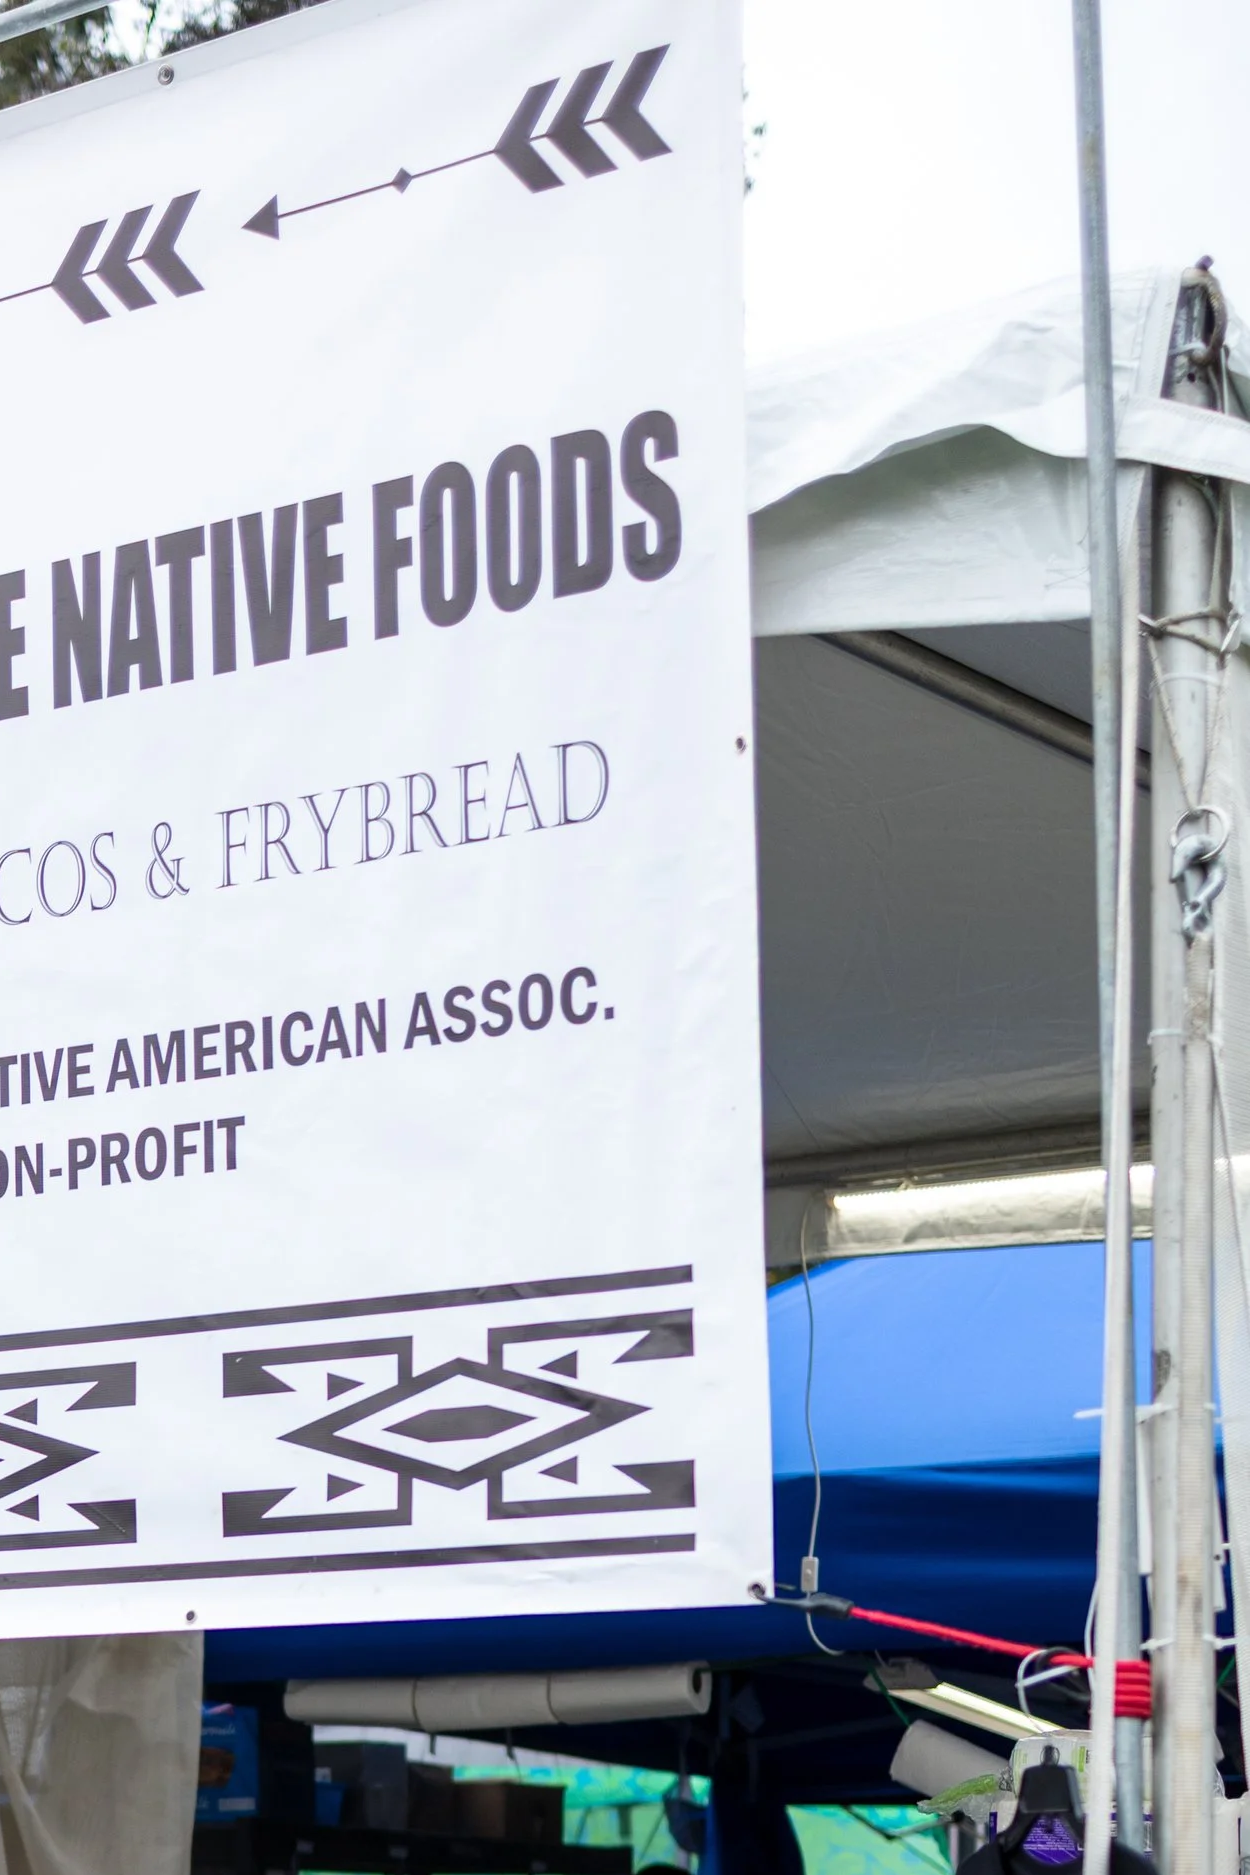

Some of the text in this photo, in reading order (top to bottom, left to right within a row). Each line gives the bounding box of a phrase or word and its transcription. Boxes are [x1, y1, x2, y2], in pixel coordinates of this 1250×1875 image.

[52, 492, 347, 709] NATIVE
[373, 410, 681, 640] FOODS
[145, 820, 190, 900] &
[216, 740, 610, 891] FRYBREAD
[106, 997, 387, 1093] AMERICAN
[403, 966, 615, 1050] ASSOC.
